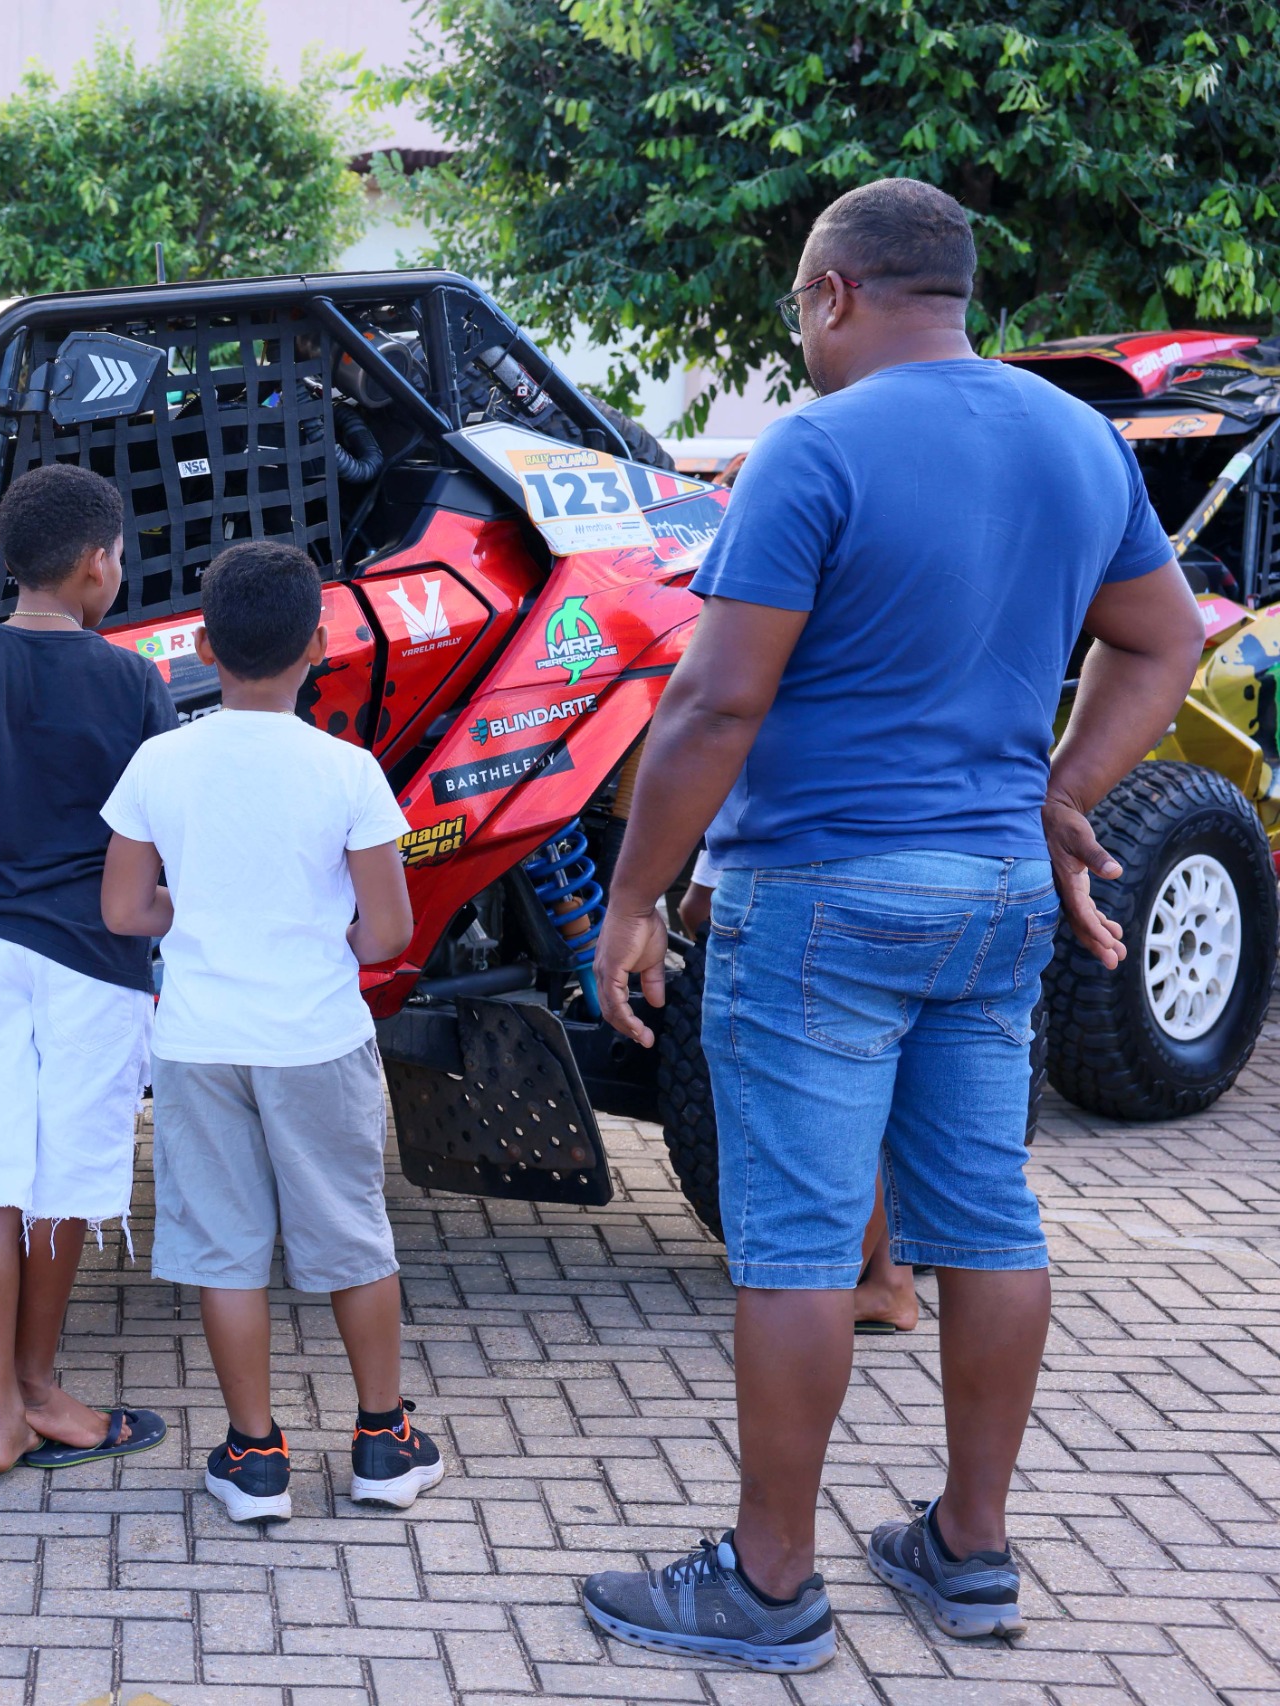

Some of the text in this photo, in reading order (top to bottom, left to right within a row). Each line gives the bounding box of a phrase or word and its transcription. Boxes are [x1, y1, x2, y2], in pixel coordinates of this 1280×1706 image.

[525, 454, 551, 465] RALLY
[524, 472, 630, 518] 123
[401, 636, 462, 657] VARELA RALLY
[536, 646, 618, 670] PERFORMANCE
[547, 634, 603, 659] MRP
[489, 694, 598, 738] BLINDARTE
[445, 752, 556, 792] BARTHELEMY
